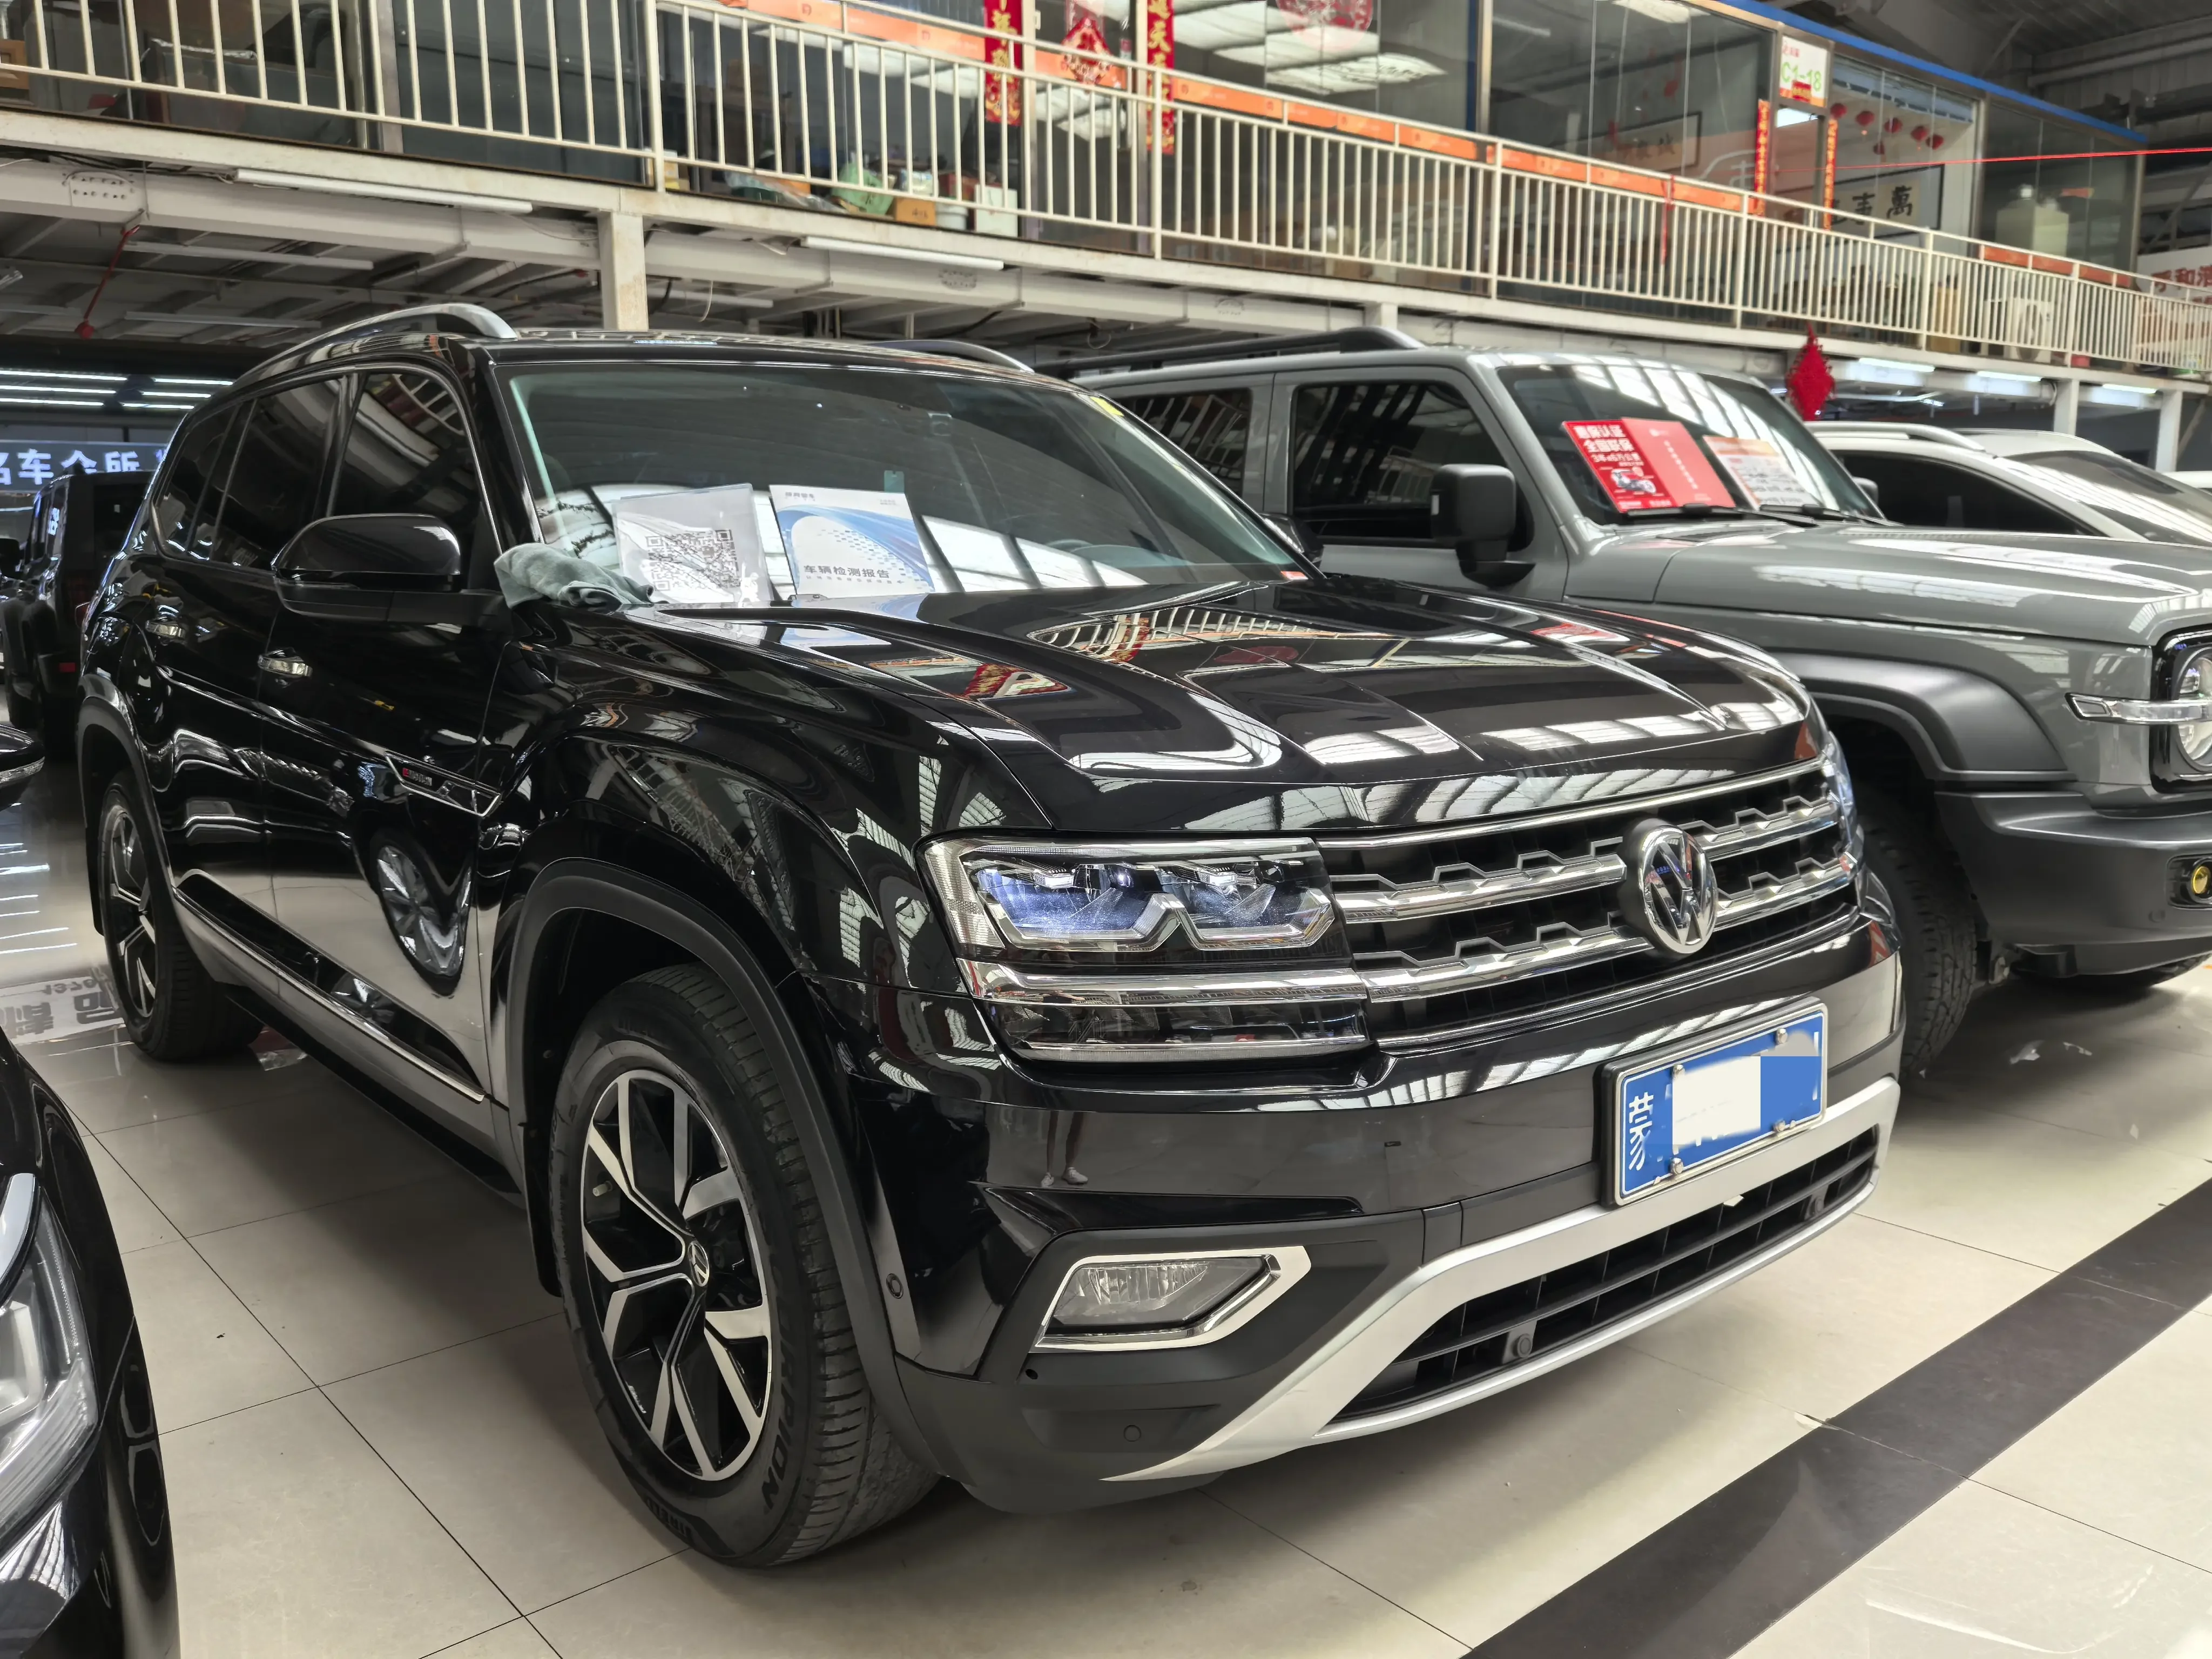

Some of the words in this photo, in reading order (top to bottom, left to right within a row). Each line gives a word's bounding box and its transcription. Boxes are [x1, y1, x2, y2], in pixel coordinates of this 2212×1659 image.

[1782, 62, 1822, 92] C1-18
[804, 565, 890, 579] 车辆检测报告
